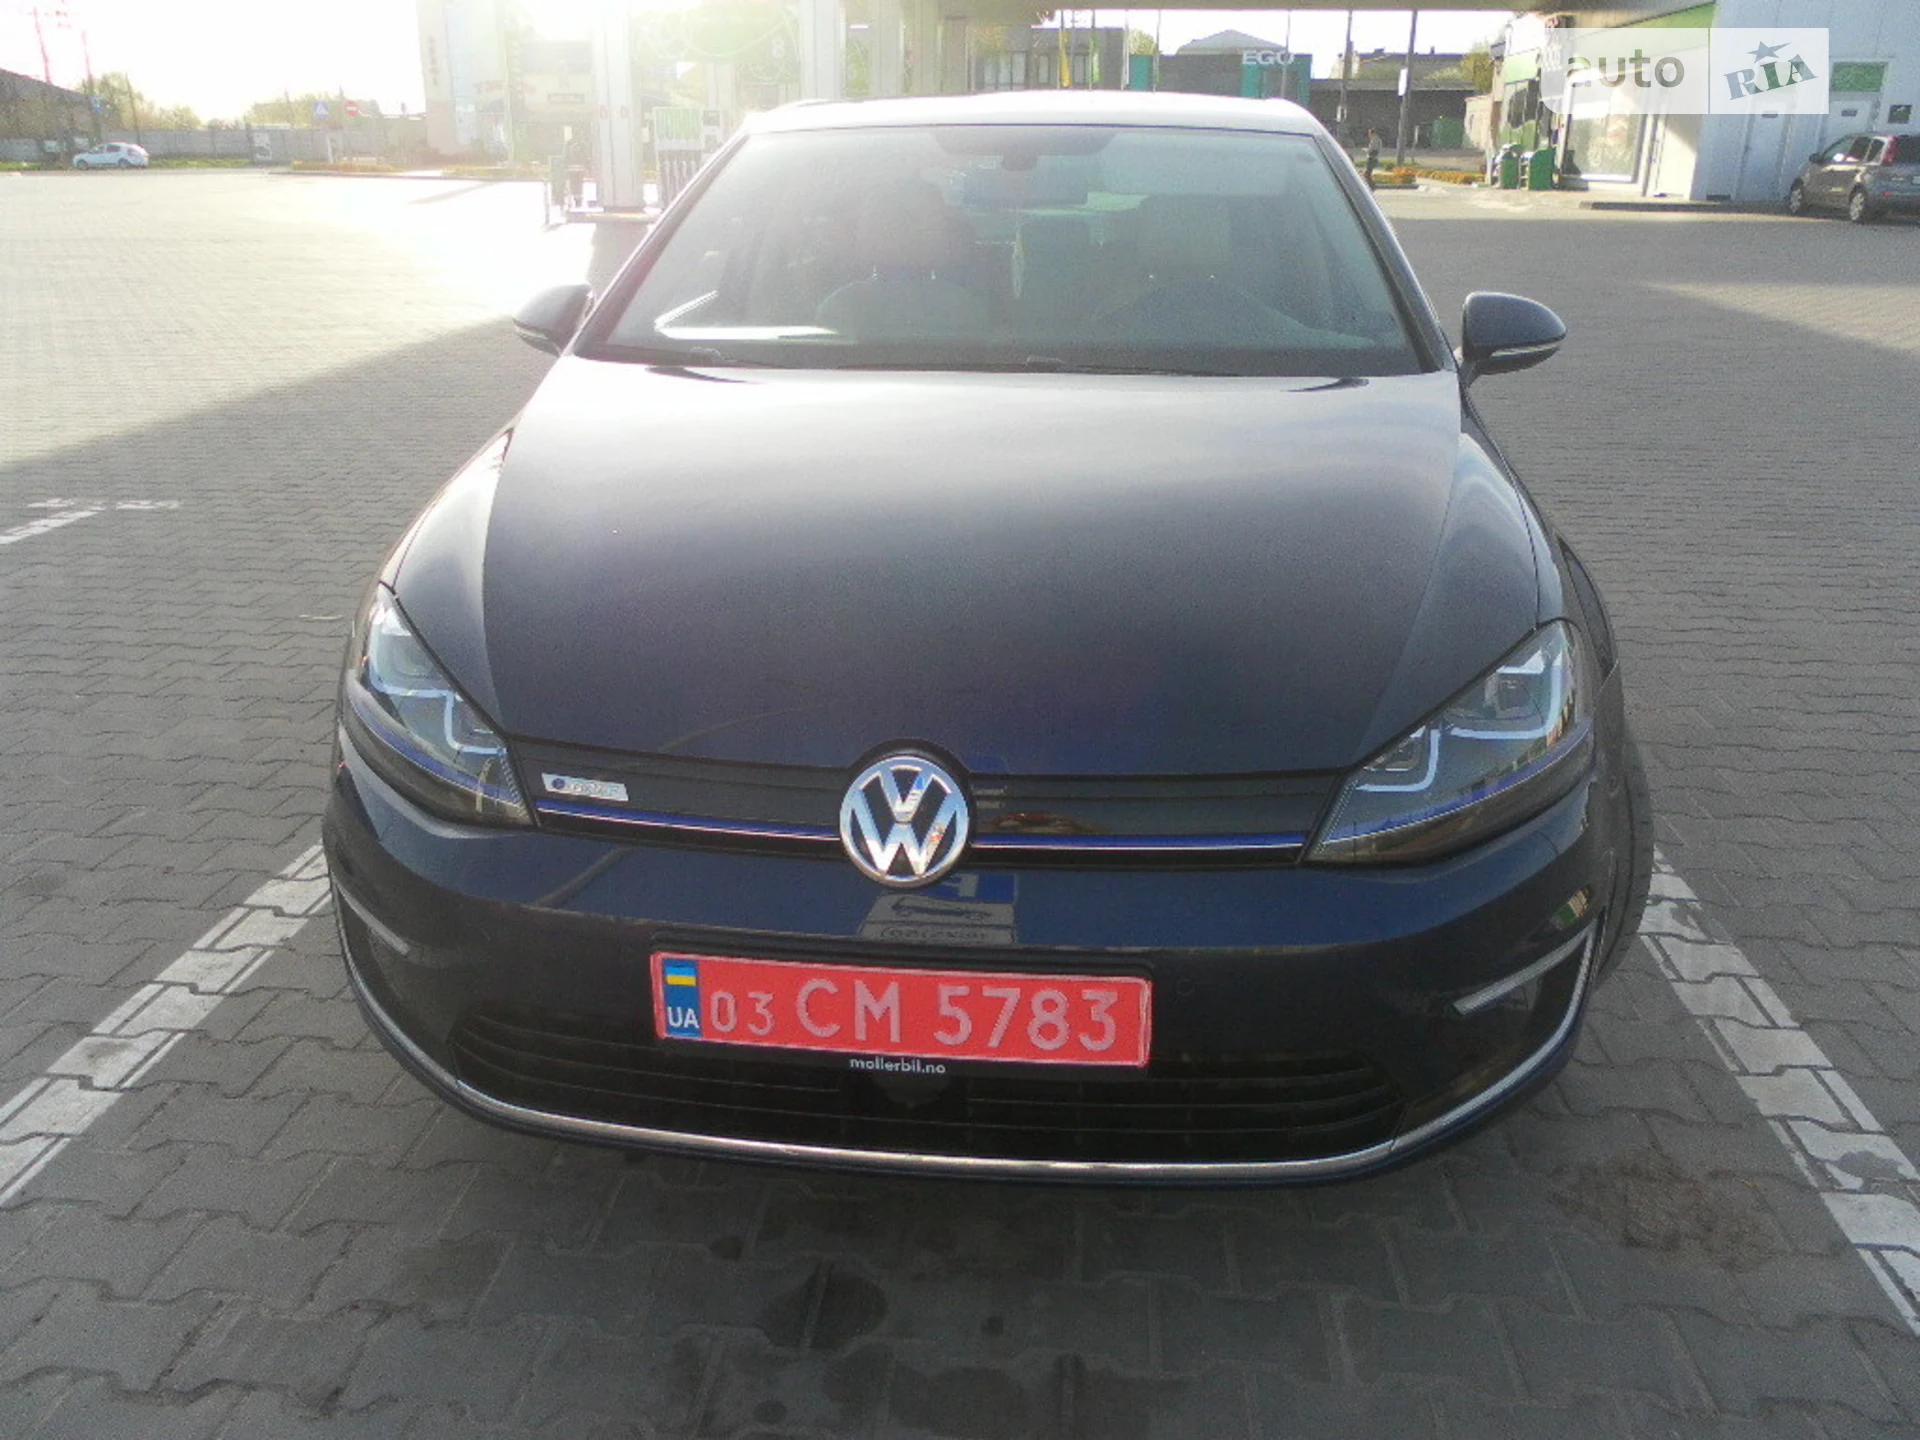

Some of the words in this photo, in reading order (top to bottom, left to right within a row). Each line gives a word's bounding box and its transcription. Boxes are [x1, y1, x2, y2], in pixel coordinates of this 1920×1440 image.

[1243, 49, 1294, 65] EGO
[667, 1006, 700, 1029] UA
[710, 990, 775, 1036] 03
[796, 978, 900, 1043] CM
[933, 983, 1118, 1051] 5783
[850, 1056, 946, 1074] mollerbil.no
